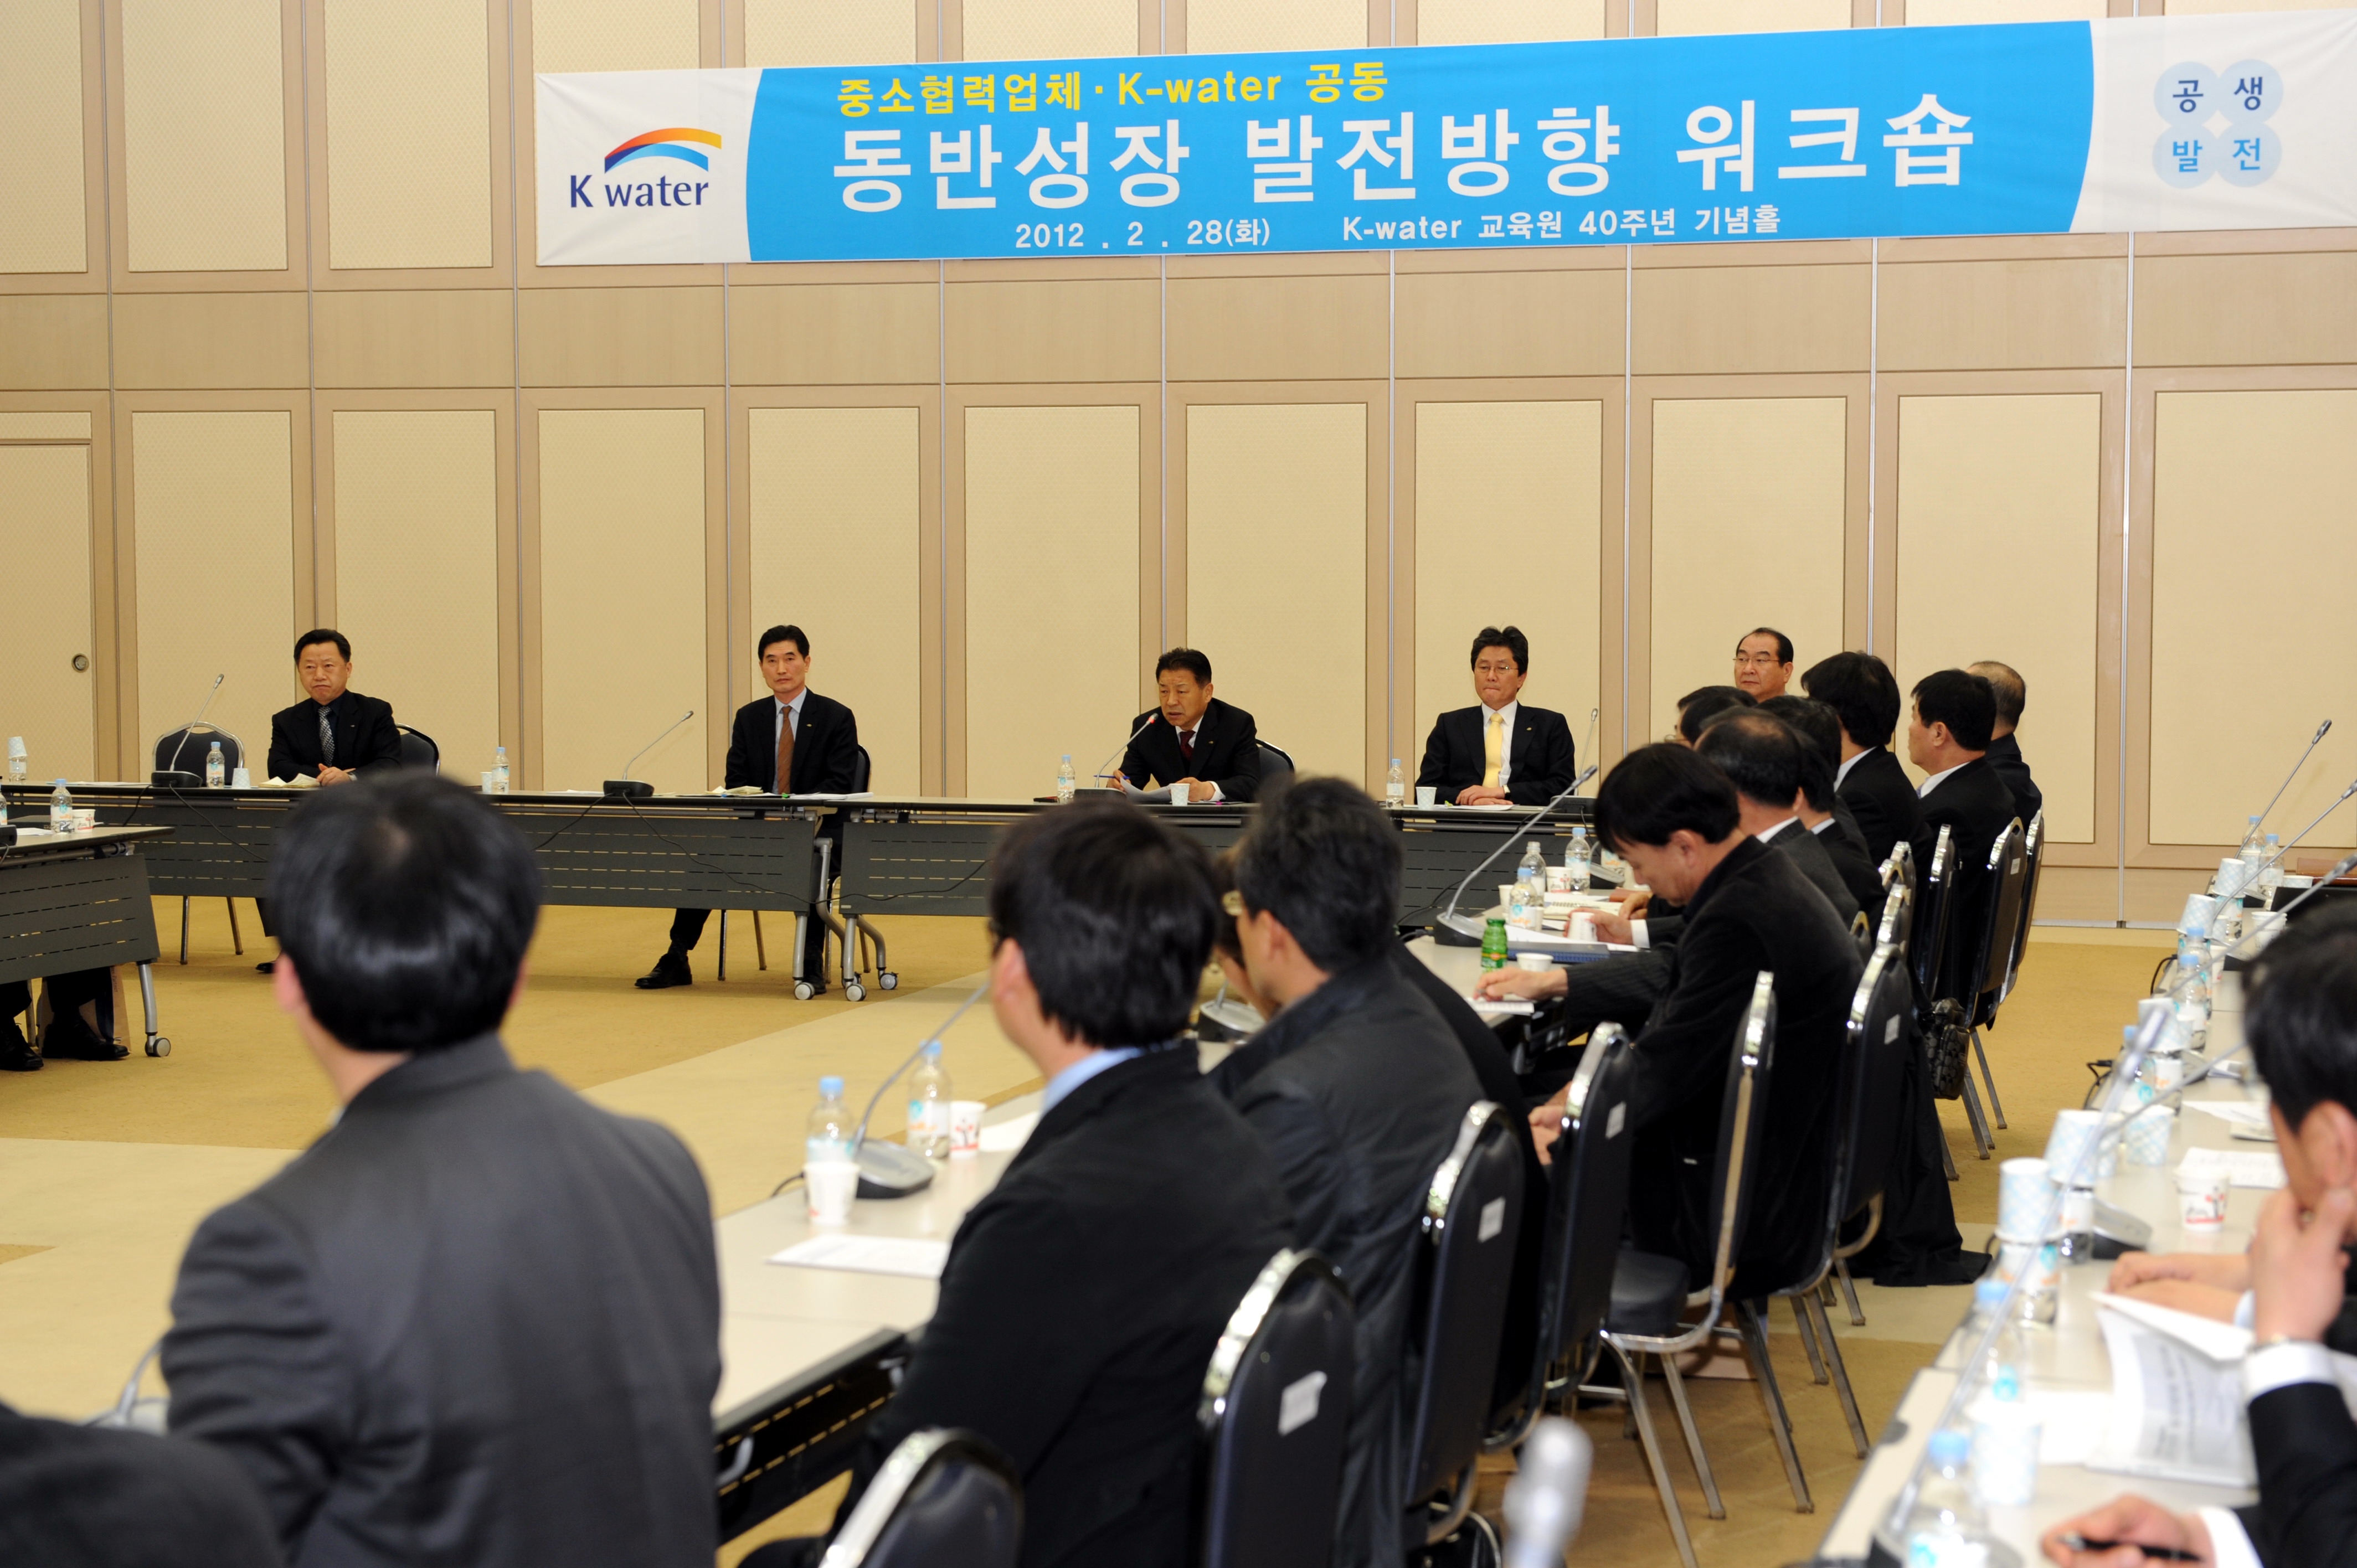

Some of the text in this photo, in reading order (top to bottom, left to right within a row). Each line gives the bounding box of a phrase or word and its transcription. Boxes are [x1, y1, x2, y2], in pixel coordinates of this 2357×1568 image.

[1306, 62, 1387, 103] 공동
[833, 94, 1974, 213] 동반성장 발전방향 워크숍
[570, 174, 709, 208] K water
[1187, 218, 1270, 246] 28(화)
[1343, 204, 1780, 241] K-water 교육원 40주년 기념홀
